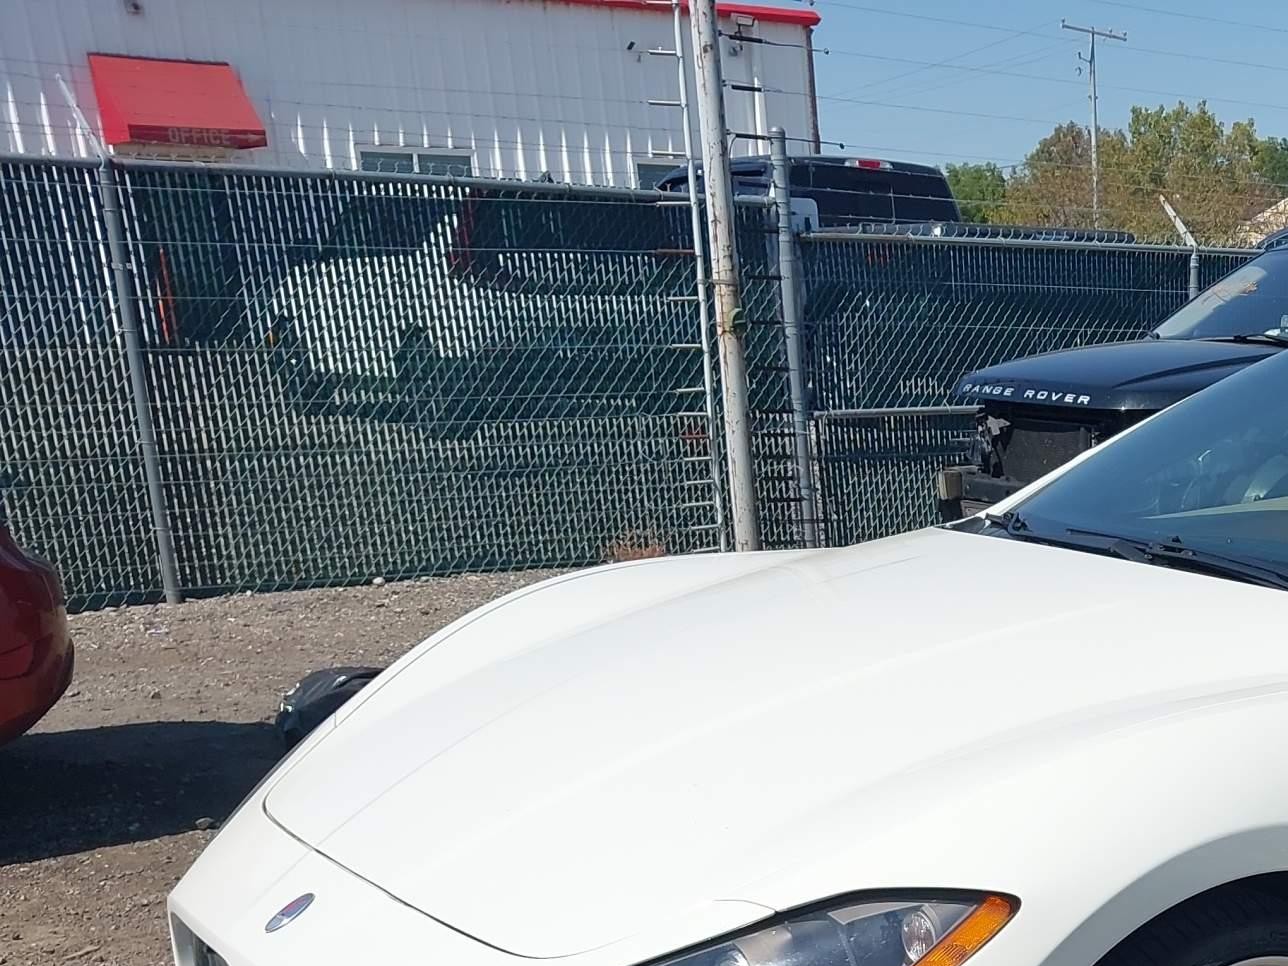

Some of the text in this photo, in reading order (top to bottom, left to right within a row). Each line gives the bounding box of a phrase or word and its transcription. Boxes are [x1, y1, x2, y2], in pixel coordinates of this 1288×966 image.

[168, 127, 231, 145] OFFICE
[963, 383, 1091, 405] RANGE ROVER
